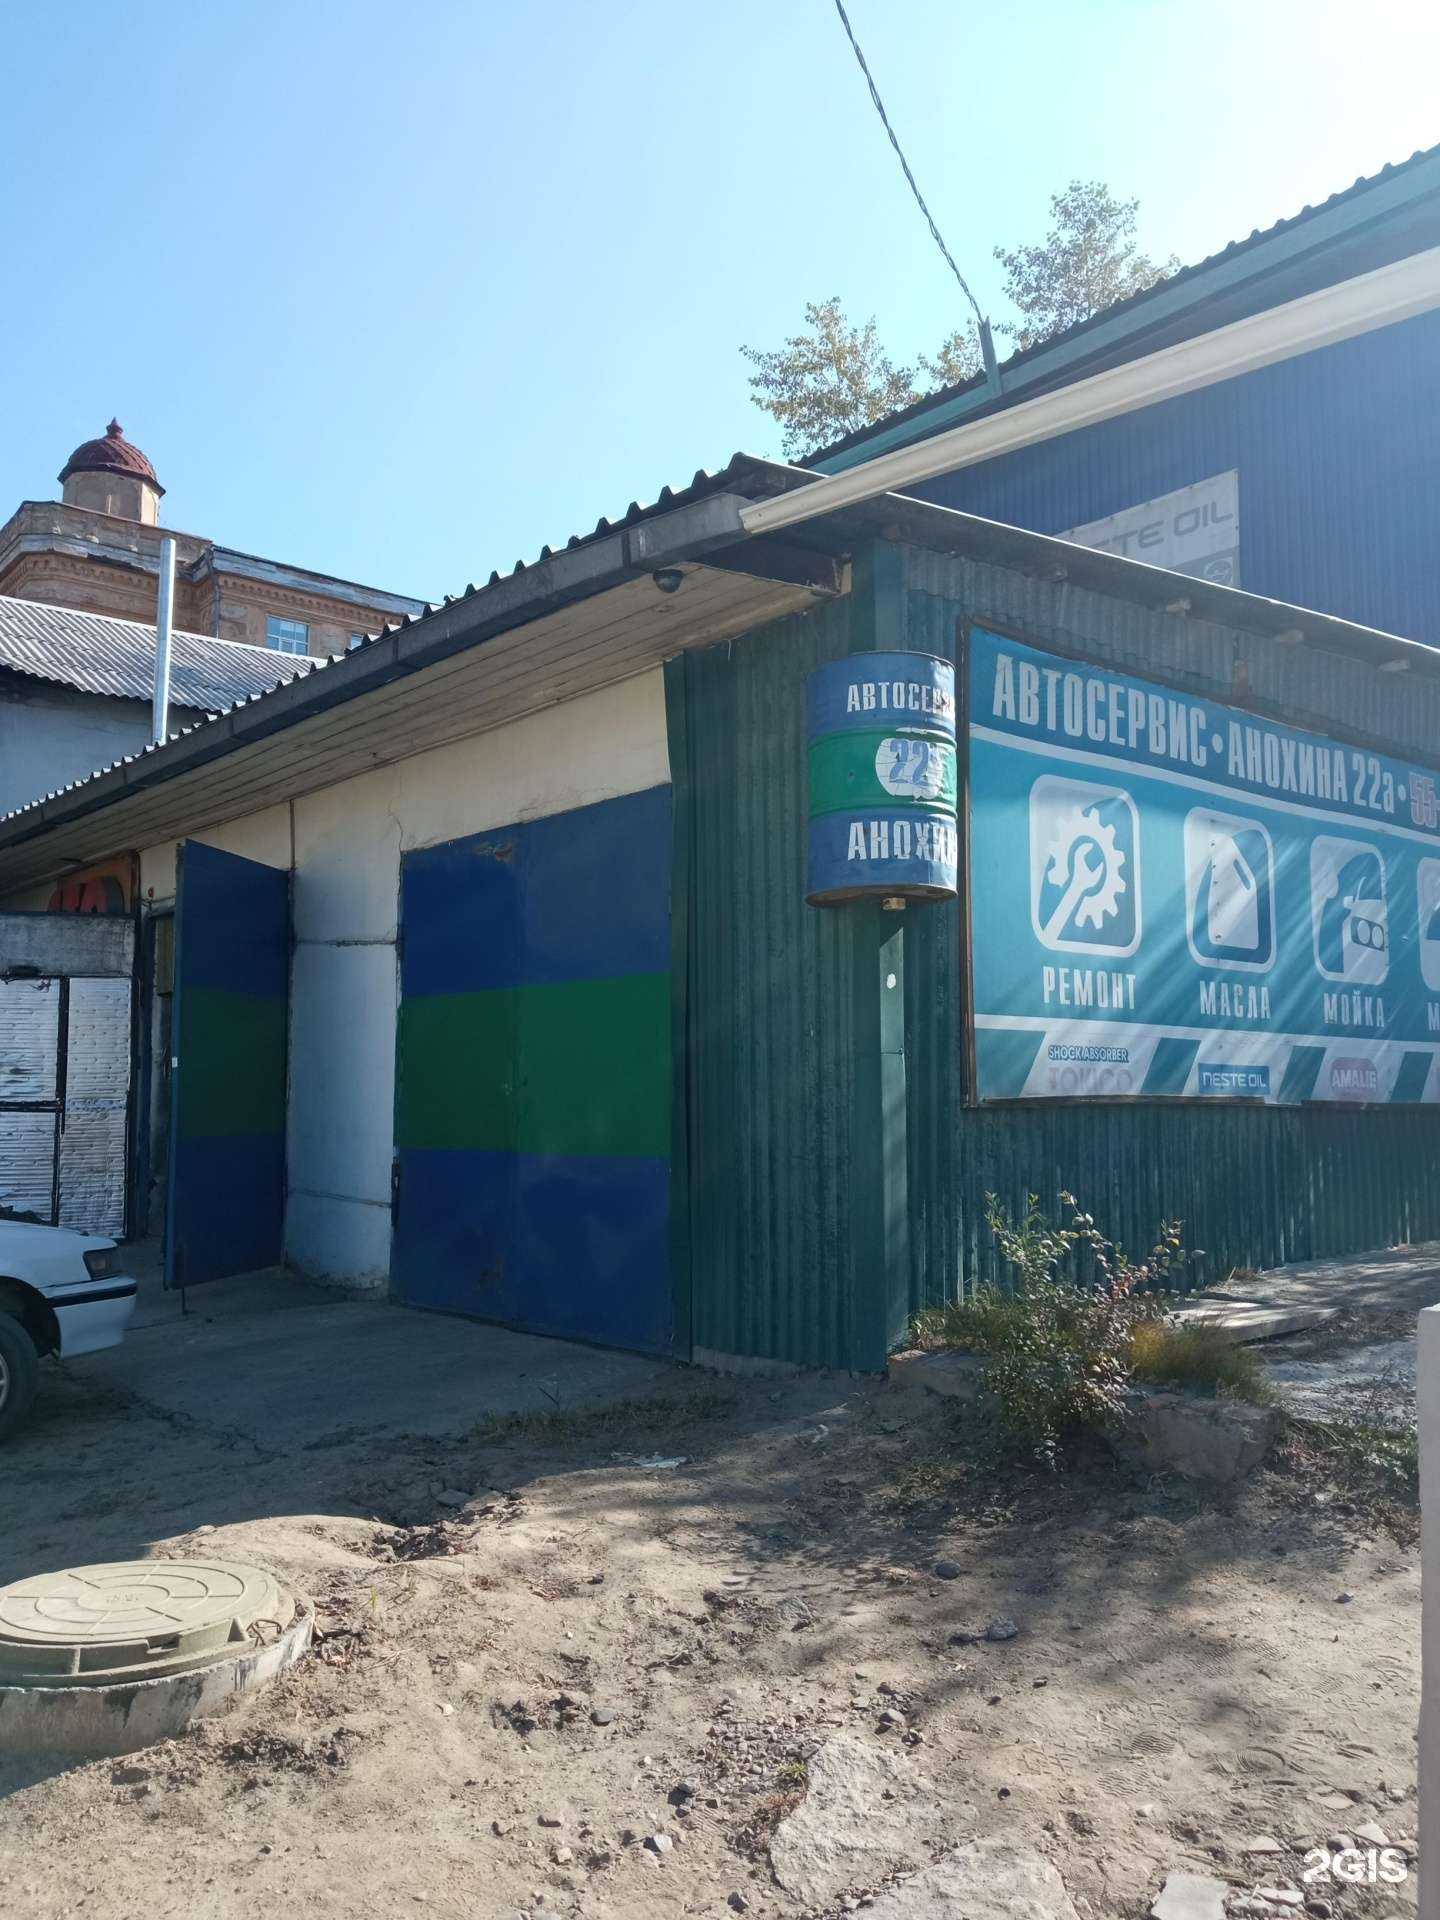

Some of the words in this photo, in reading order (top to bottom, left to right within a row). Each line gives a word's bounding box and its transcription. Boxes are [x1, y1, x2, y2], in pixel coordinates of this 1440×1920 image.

[1174, 501, 1234, 536] OIL
[993, 653, 1207, 767] АВТОСЕРВИС
[1228, 721, 1348, 802] АНОХИНА
[1043, 966, 1136, 1010] РЕМОНТ
[1200, 981, 1272, 1020] МАСЛА
[1324, 989, 1386, 1028] МОЙКА
[1249, 1075, 1267, 1088] OIL
[1331, 1069, 1377, 1089] AMALIE
